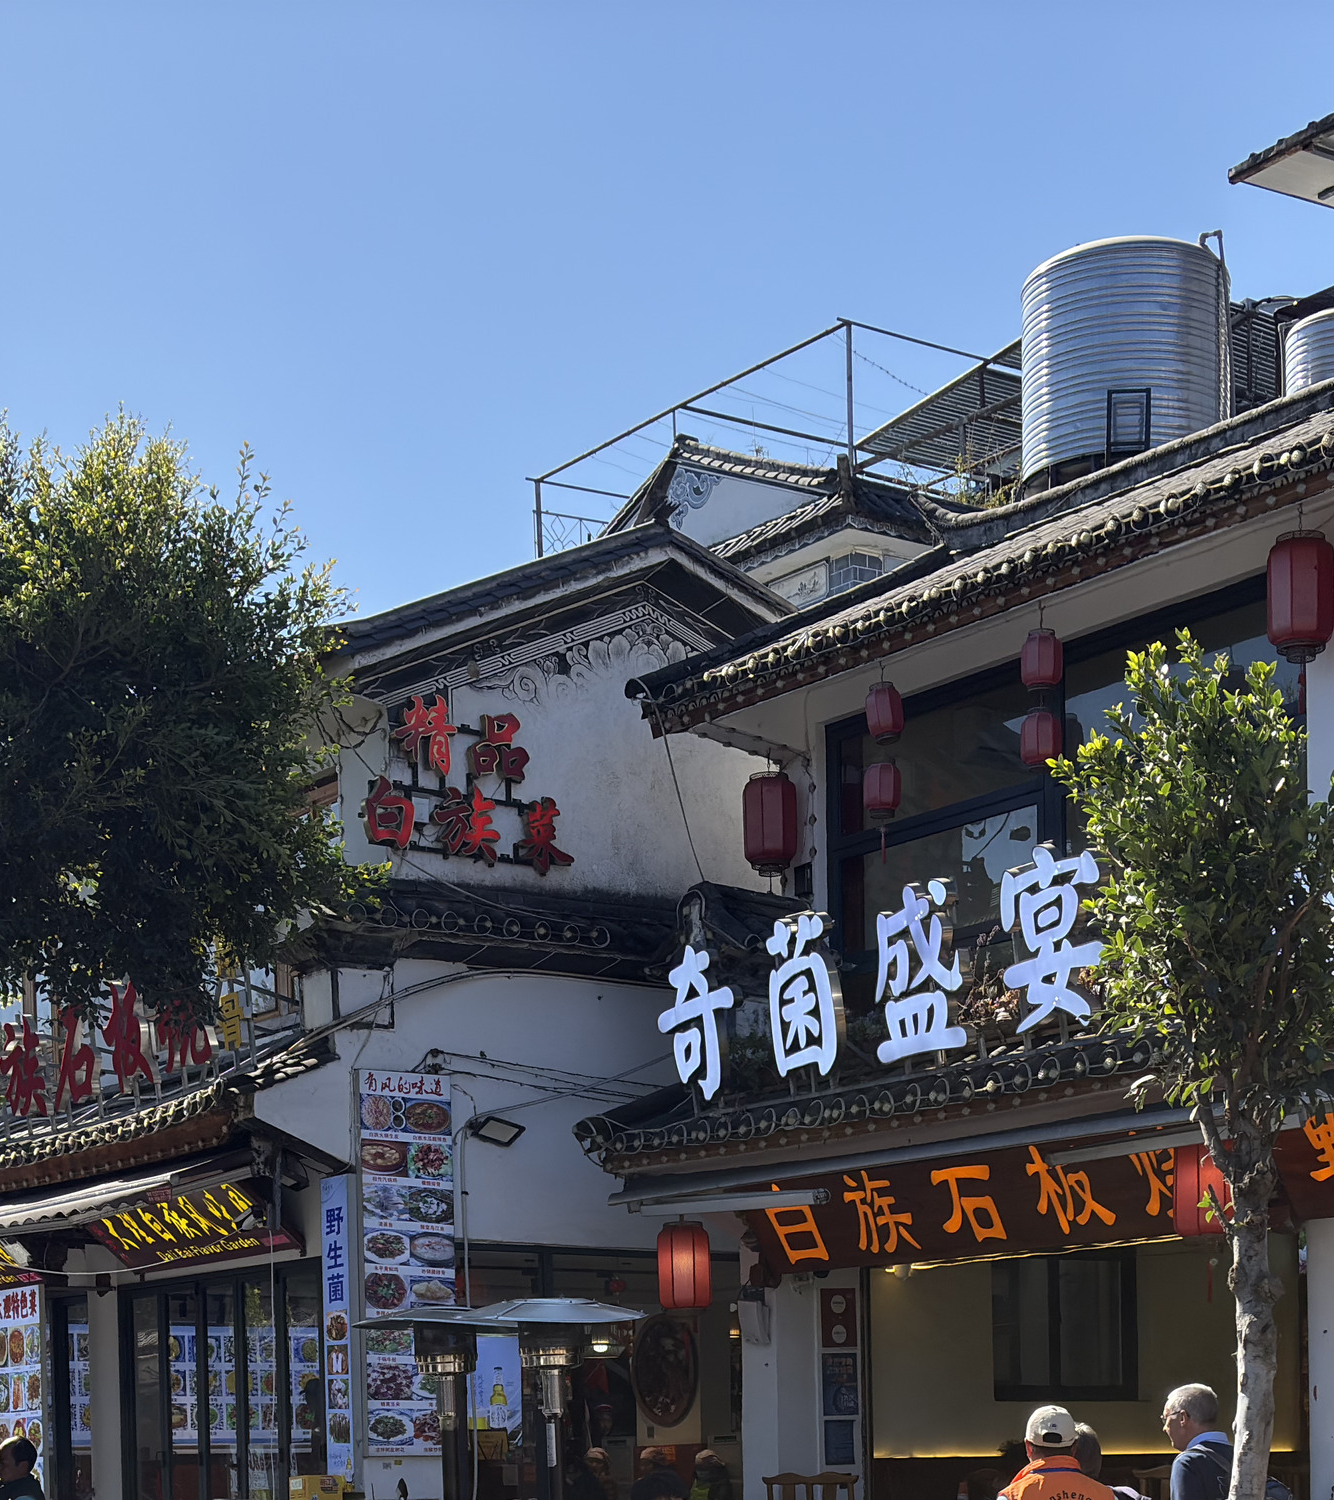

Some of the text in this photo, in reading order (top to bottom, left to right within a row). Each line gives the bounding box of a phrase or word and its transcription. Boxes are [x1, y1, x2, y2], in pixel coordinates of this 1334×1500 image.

[393, 694, 530, 778] 精品
[366, 775, 575, 876] 白族菜
[658, 846, 1104, 1100] 奇菌盛宴
[364, 1072, 444, 1097] 有风的味道
[220, 1236, 261, 1251] Garden
[325, 1206, 346, 1304] 野生菌
